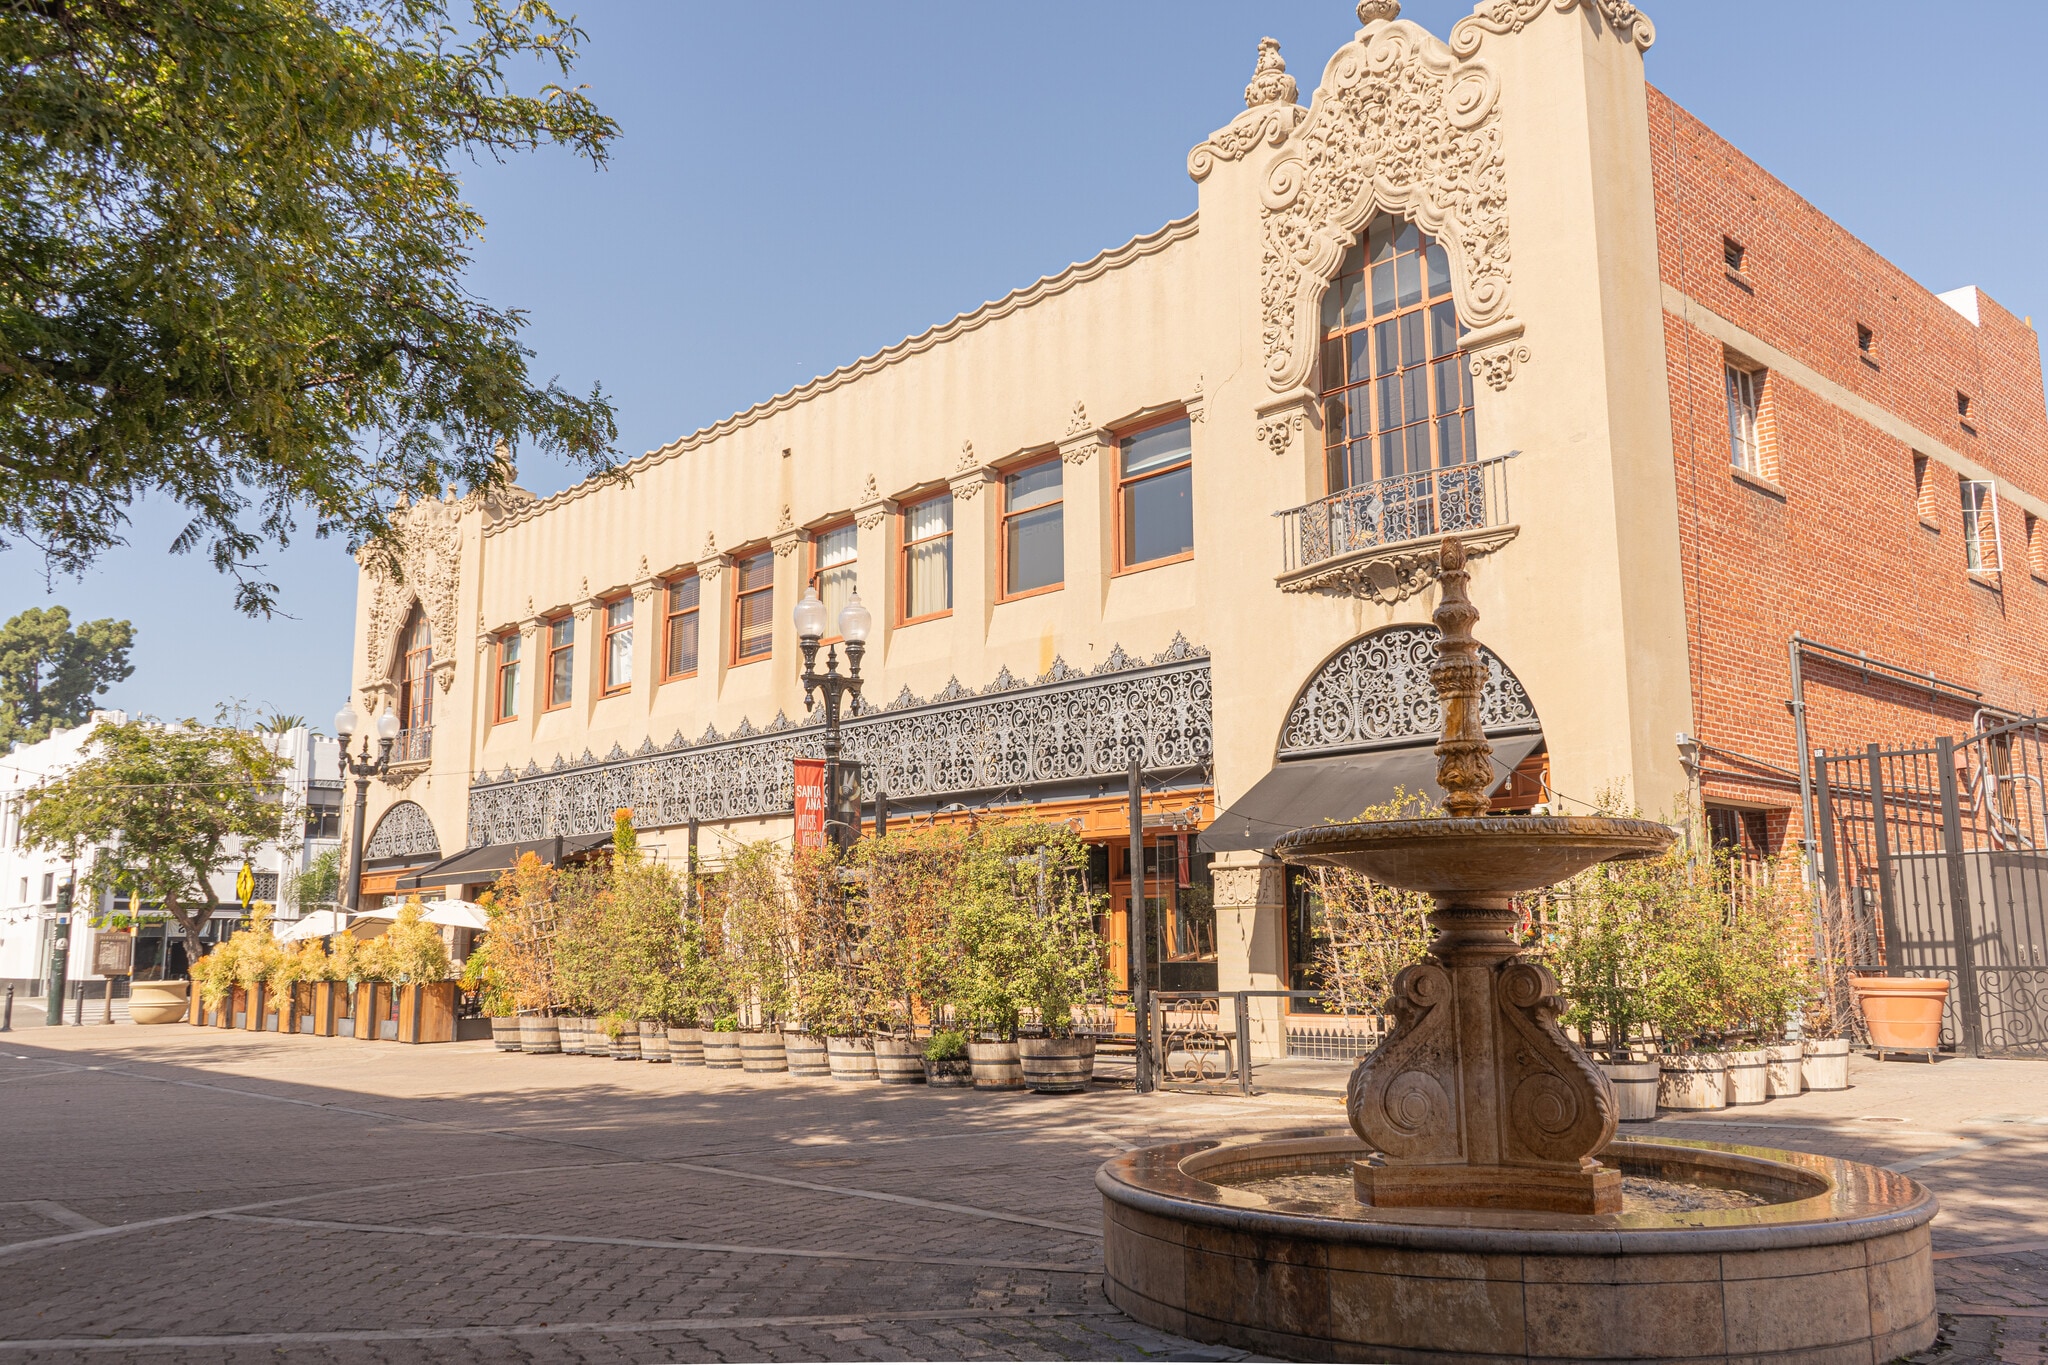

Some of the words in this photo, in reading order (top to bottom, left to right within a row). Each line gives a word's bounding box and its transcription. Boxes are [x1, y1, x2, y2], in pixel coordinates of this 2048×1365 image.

[796, 785, 821, 798] SANTA
[805, 797, 821, 810] ANA
[798, 814, 817, 830] ARTISTS
